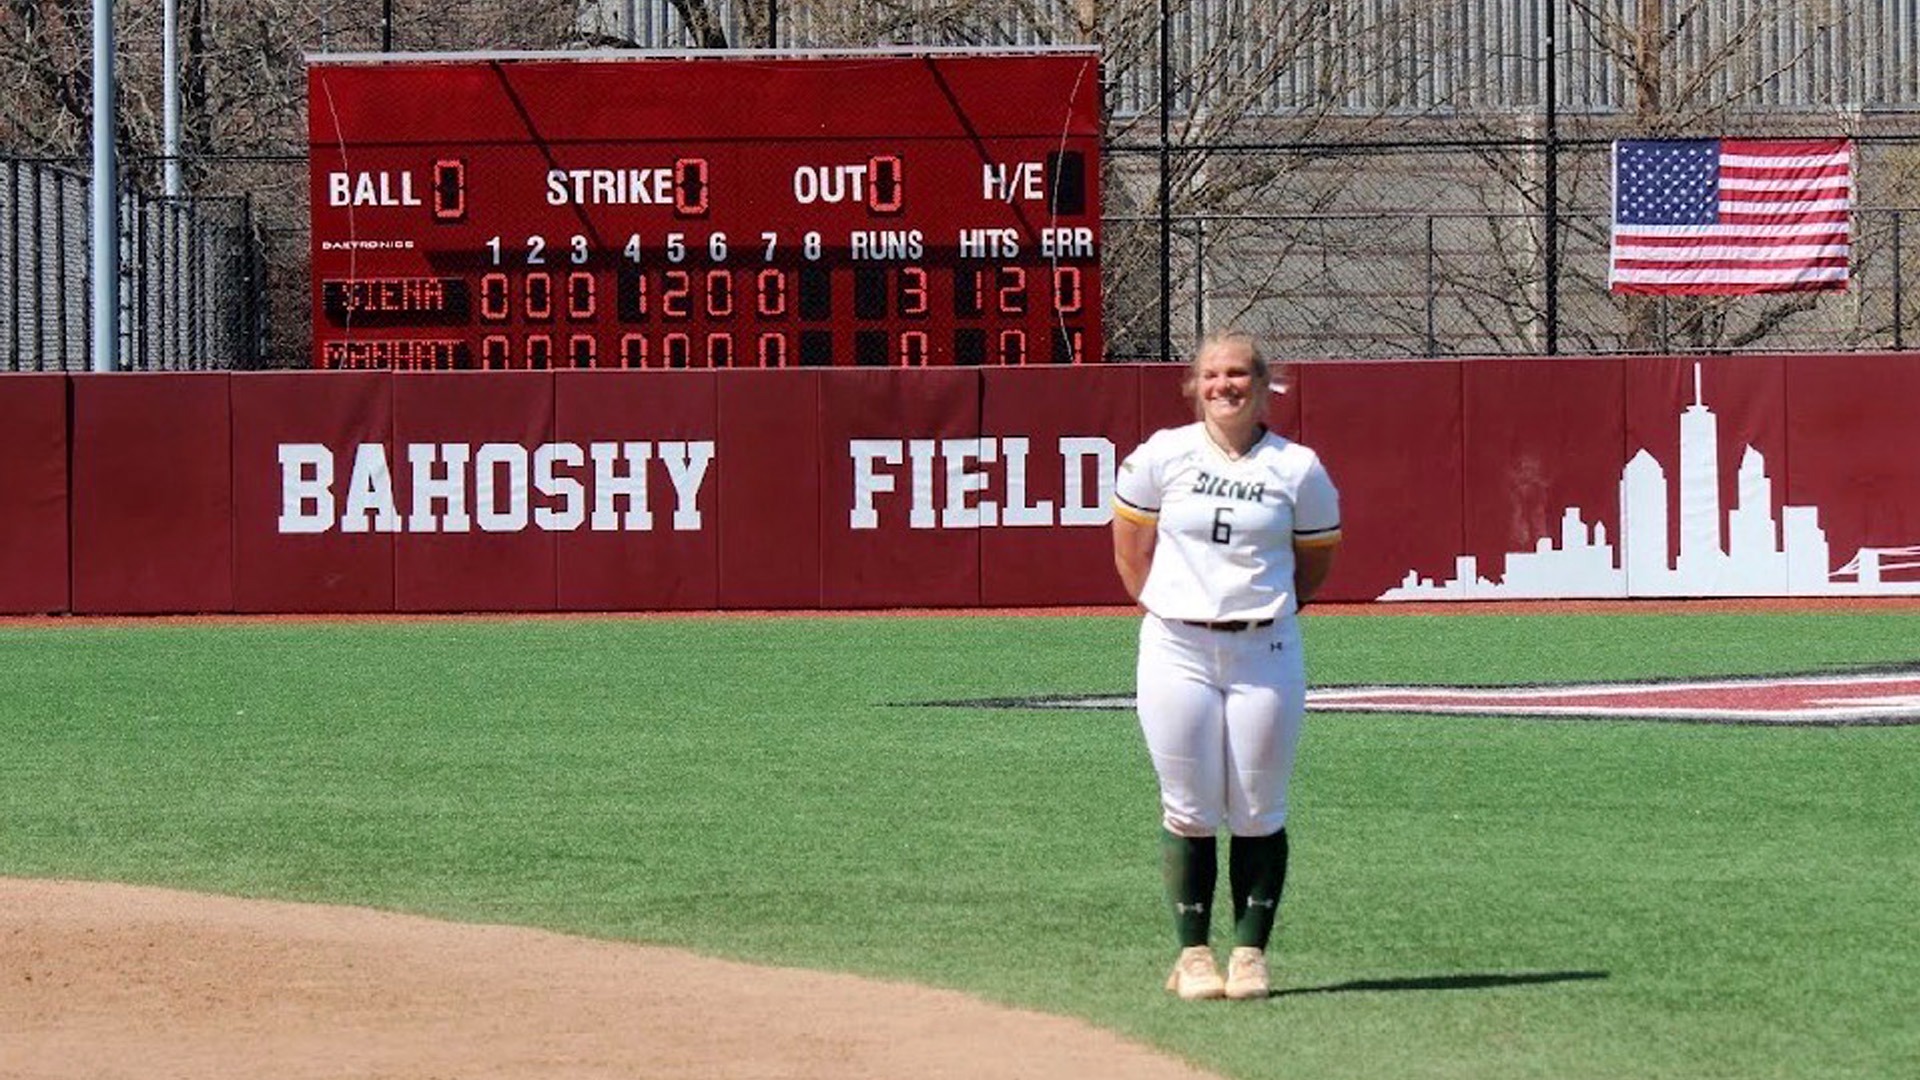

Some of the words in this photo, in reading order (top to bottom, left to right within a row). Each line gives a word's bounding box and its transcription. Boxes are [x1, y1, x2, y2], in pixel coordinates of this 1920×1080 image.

[329, 171, 422, 206] BALL
[434, 160, 464, 217] 0
[546, 168, 674, 206] STRIKE
[675, 158, 708, 213] 0
[794, 165, 867, 203] OUT
[868, 155, 901, 211] 0
[983, 163, 1043, 203] H/E
[486, 236, 500, 265] 1
[526, 235, 546, 264] 2
[570, 234, 589, 264] 3
[623, 233, 641, 262] 4
[667, 233, 685, 262] 5
[709, 231, 727, 261] 6
[761, 231, 778, 261] 7
[803, 231, 822, 260] 8
[851, 229, 923, 260] RUNS
[959, 228, 1019, 258] HITS
[1041, 227, 1093, 258] ERR
[342, 279, 442, 310] SIENA
[481, 272, 508, 318] 0
[526, 272, 550, 318] 0
[568, 271, 595, 318] 0
[639, 273, 647, 314] 1
[663, 270, 689, 316] 2
[707, 269, 732, 315] 0
[758, 268, 785, 315] 0
[903, 266, 927, 313] 3
[1054, 266, 1081, 312] 0
[278, 441, 715, 533] BAHOSHY
[849, 437, 1116, 529] FIELD
[1192, 472, 1265, 502] SIENA
[1211, 507, 1234, 545] 6
